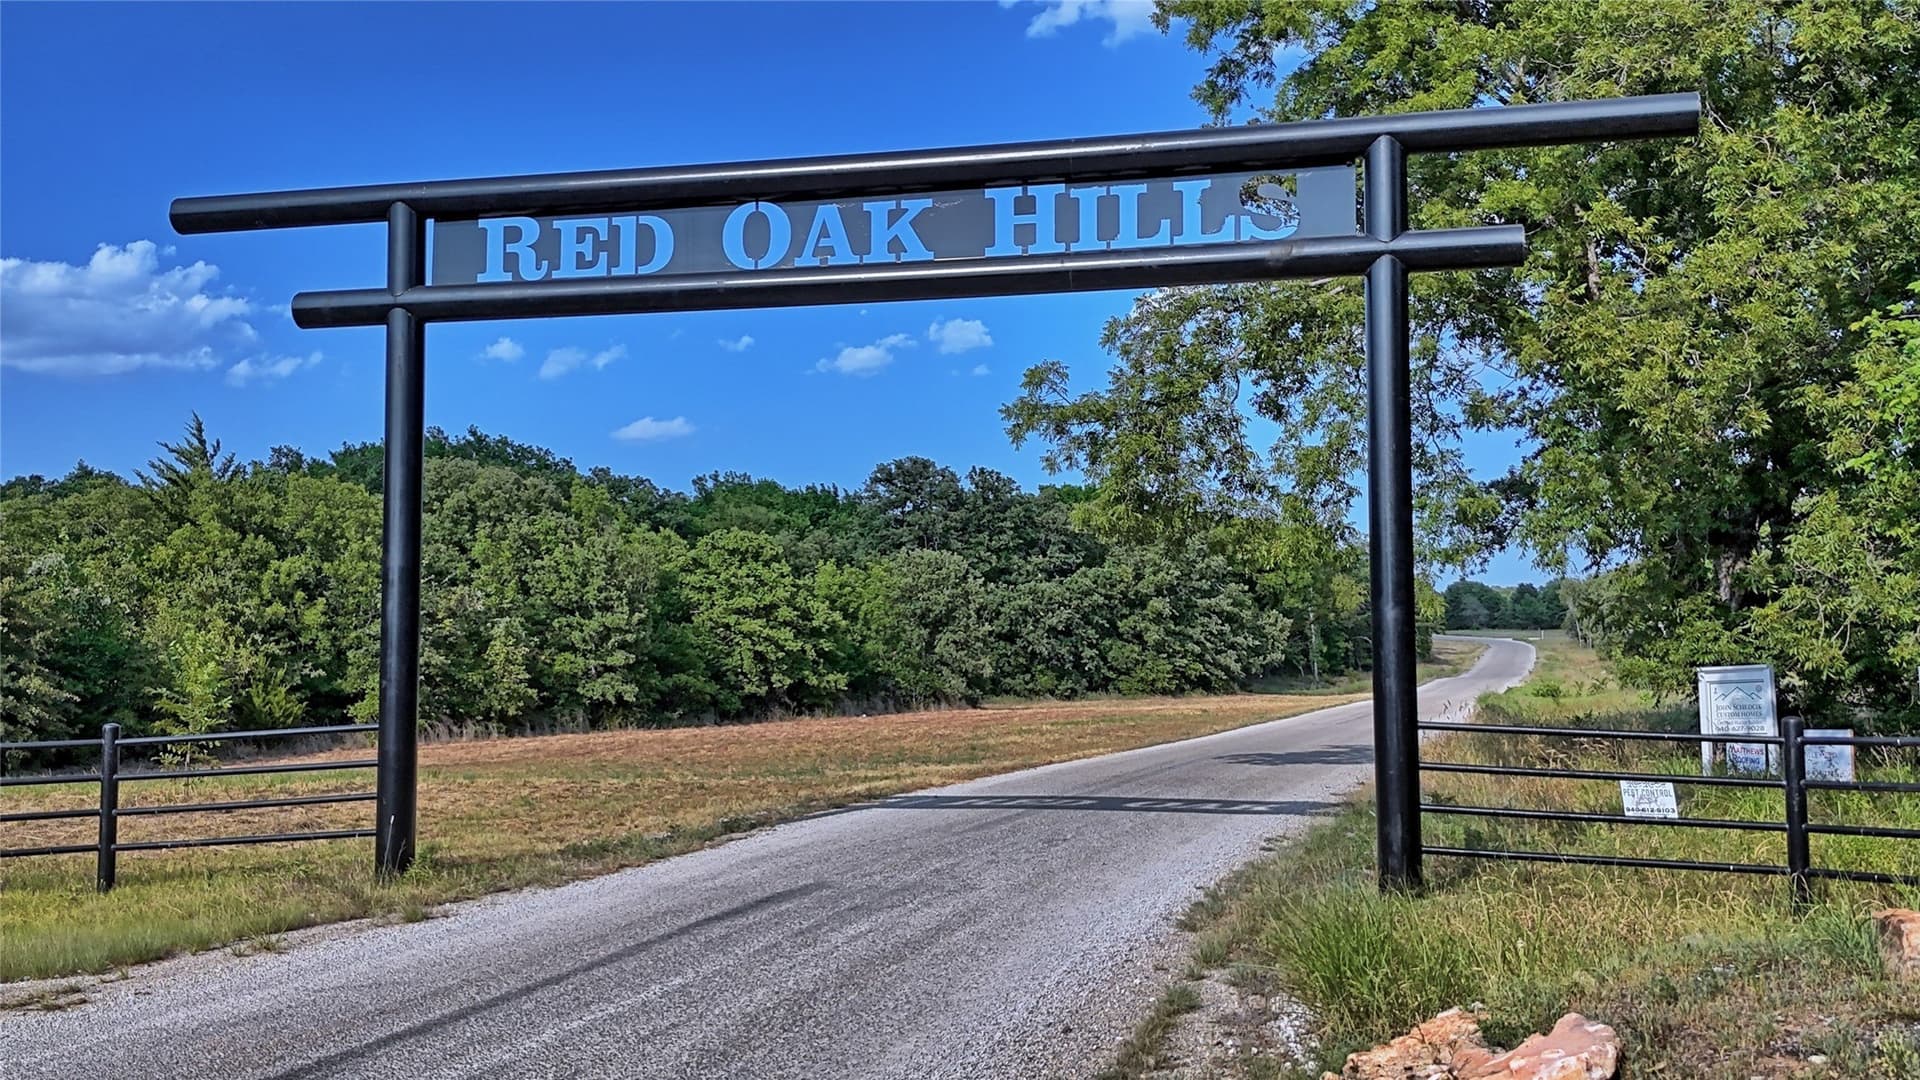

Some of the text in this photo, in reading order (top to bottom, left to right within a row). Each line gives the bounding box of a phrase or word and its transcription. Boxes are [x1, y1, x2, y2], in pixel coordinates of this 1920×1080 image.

[477, 173, 1301, 283] RED OAK HILLS
[1623, 788, 1673, 798] PEST CONTROL
